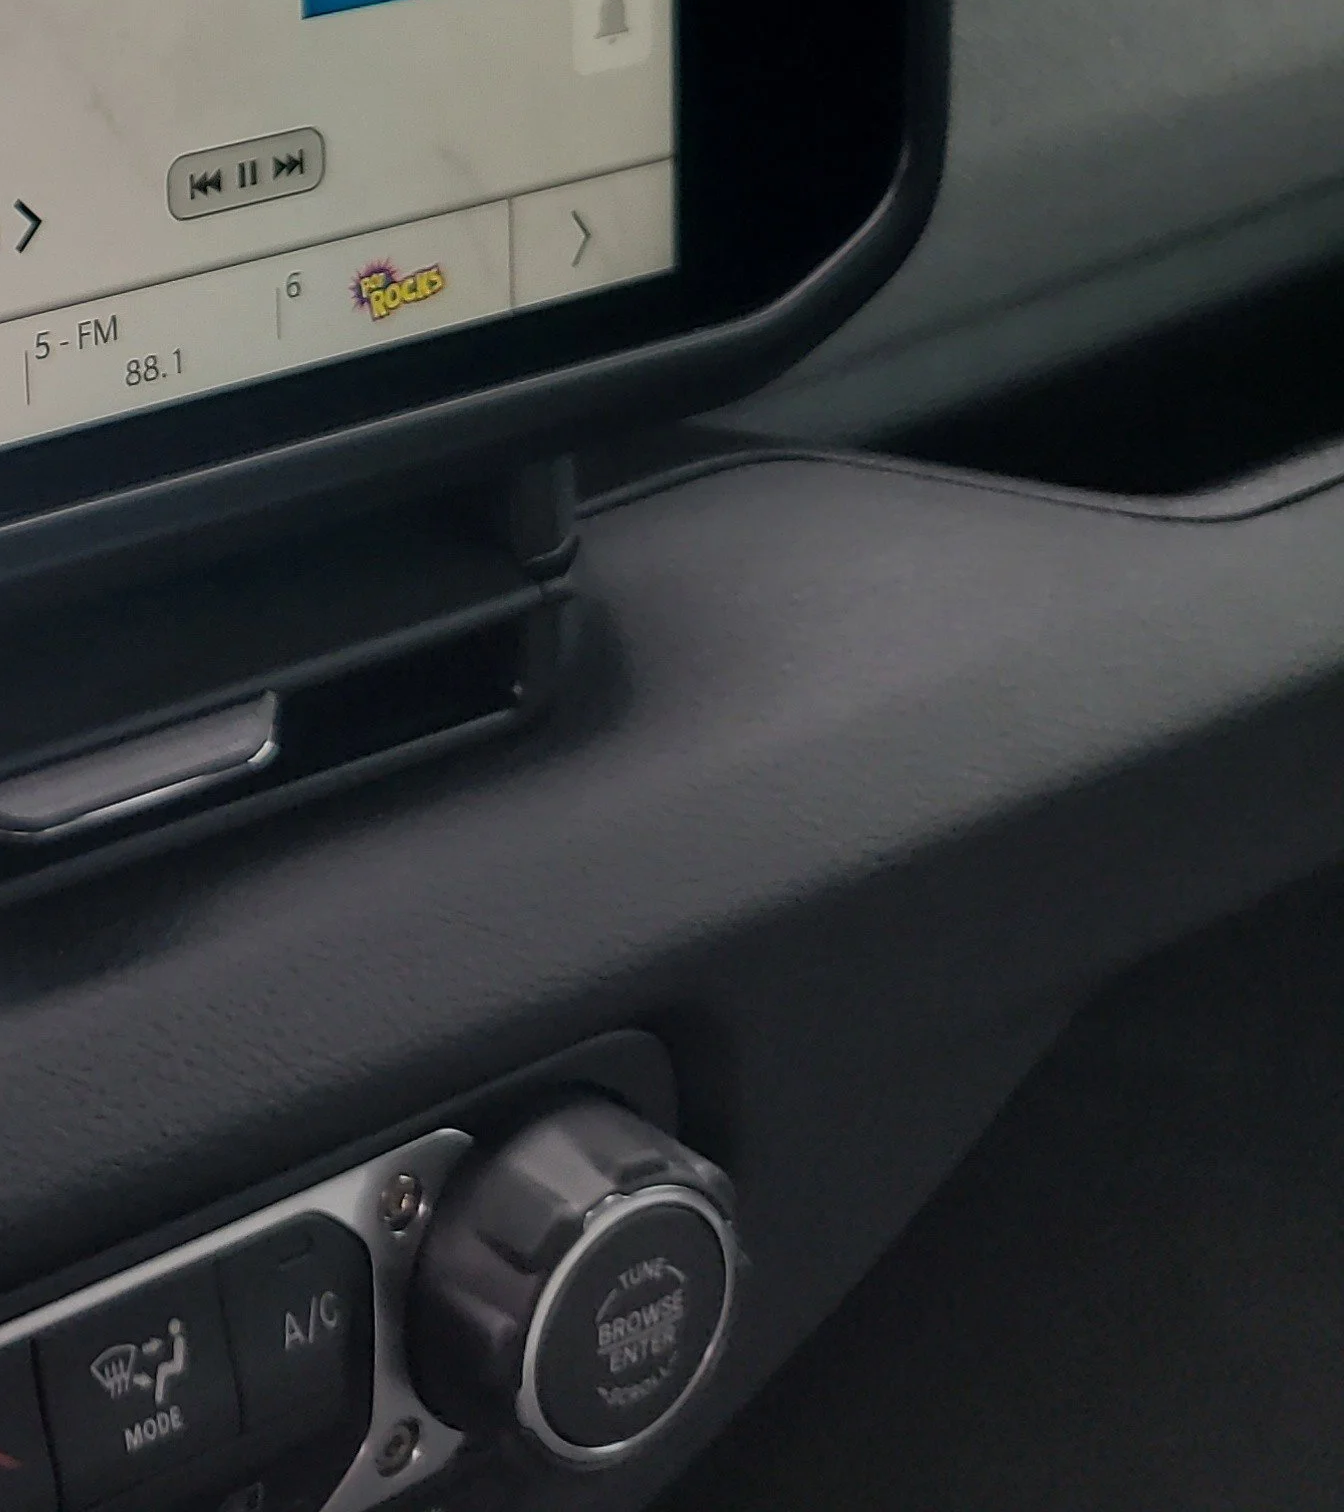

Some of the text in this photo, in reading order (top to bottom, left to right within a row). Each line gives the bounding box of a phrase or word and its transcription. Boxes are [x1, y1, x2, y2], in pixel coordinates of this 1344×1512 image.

[286, 272, 301, 299] 6
[34, 332, 50, 360] 5
[77, 316, 118, 351] FM
[125, 349, 183, 387] 88.1
[283, 1291, 342, 1352] A/C
[599, 1288, 683, 1346] BROWSE
[124, 1406, 183, 1451] MODE
